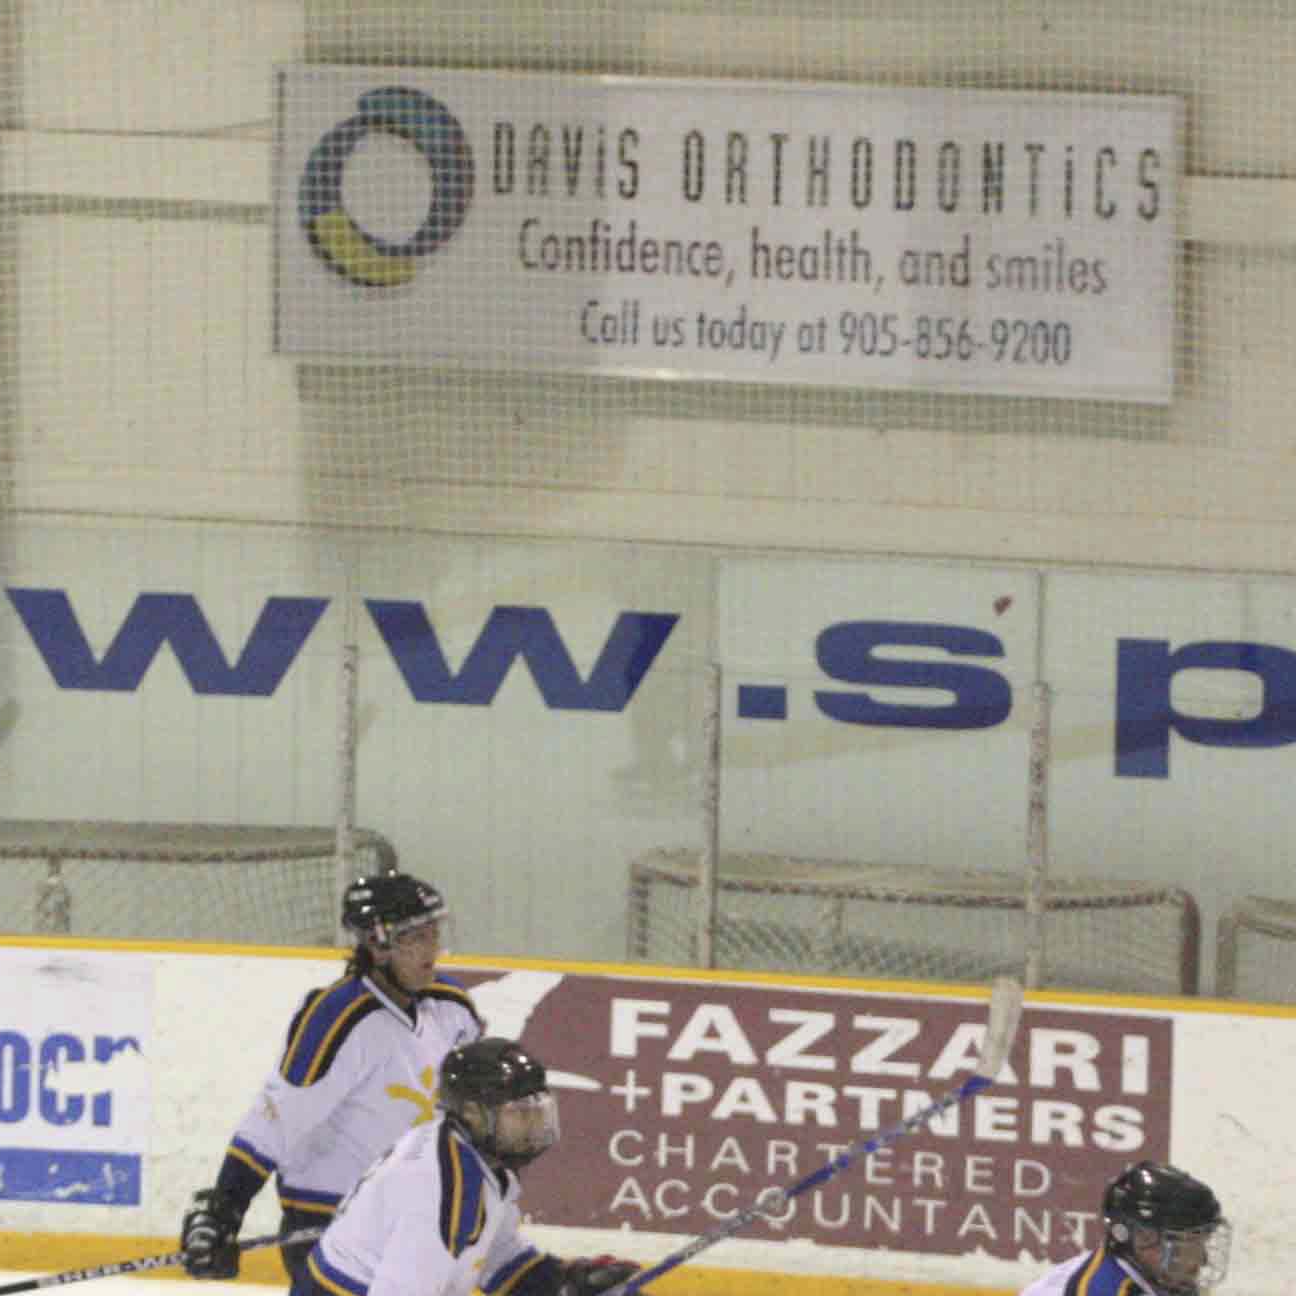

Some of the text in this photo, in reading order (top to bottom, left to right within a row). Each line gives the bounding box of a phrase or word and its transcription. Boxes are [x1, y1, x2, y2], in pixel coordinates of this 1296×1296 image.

[518, 219, 1109, 296] Confidence, health, and smiles
[580, 306, 1074, 367] Call us today at 905-856-9200
[610, 996, 1152, 1095] FAZZARI
[608, 1130, 1052, 1196] CHARTERED
